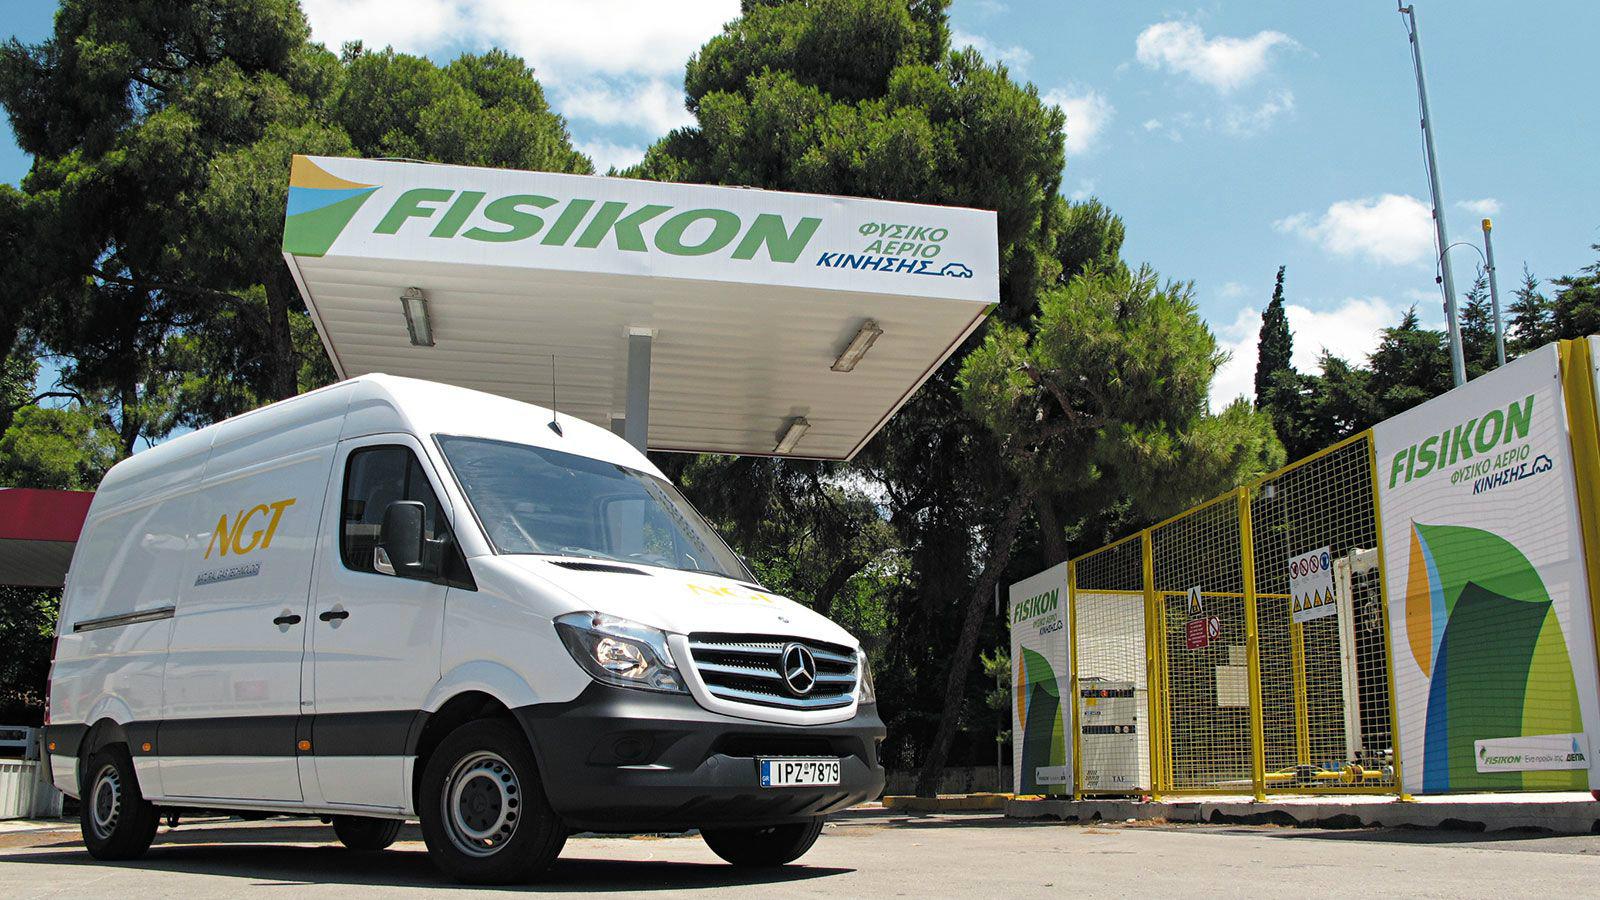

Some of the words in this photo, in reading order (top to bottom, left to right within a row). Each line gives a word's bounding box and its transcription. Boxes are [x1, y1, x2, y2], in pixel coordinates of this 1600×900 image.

[372, 188, 823, 263] FISIKON
[858, 222, 949, 243] ΦΥΣΙΚΟ
[816, 252, 935, 275] ΚΙΝΗΣΗΣ
[863, 239, 941, 259] ΑΕΡΙΟ
[1389, 394, 1535, 489] FISIKON
[1450, 457, 1491, 485] ΦΥΣΙΚΟ
[1493, 443, 1530, 471] ΑΕΡΙΟ
[1472, 463, 1530, 495] ΚΙΝΗΣΗΣ
[204, 498, 296, 560] NGT
[1013, 588, 1059, 624] FISIKON
[1484, 755, 1521, 765] FISIKON
